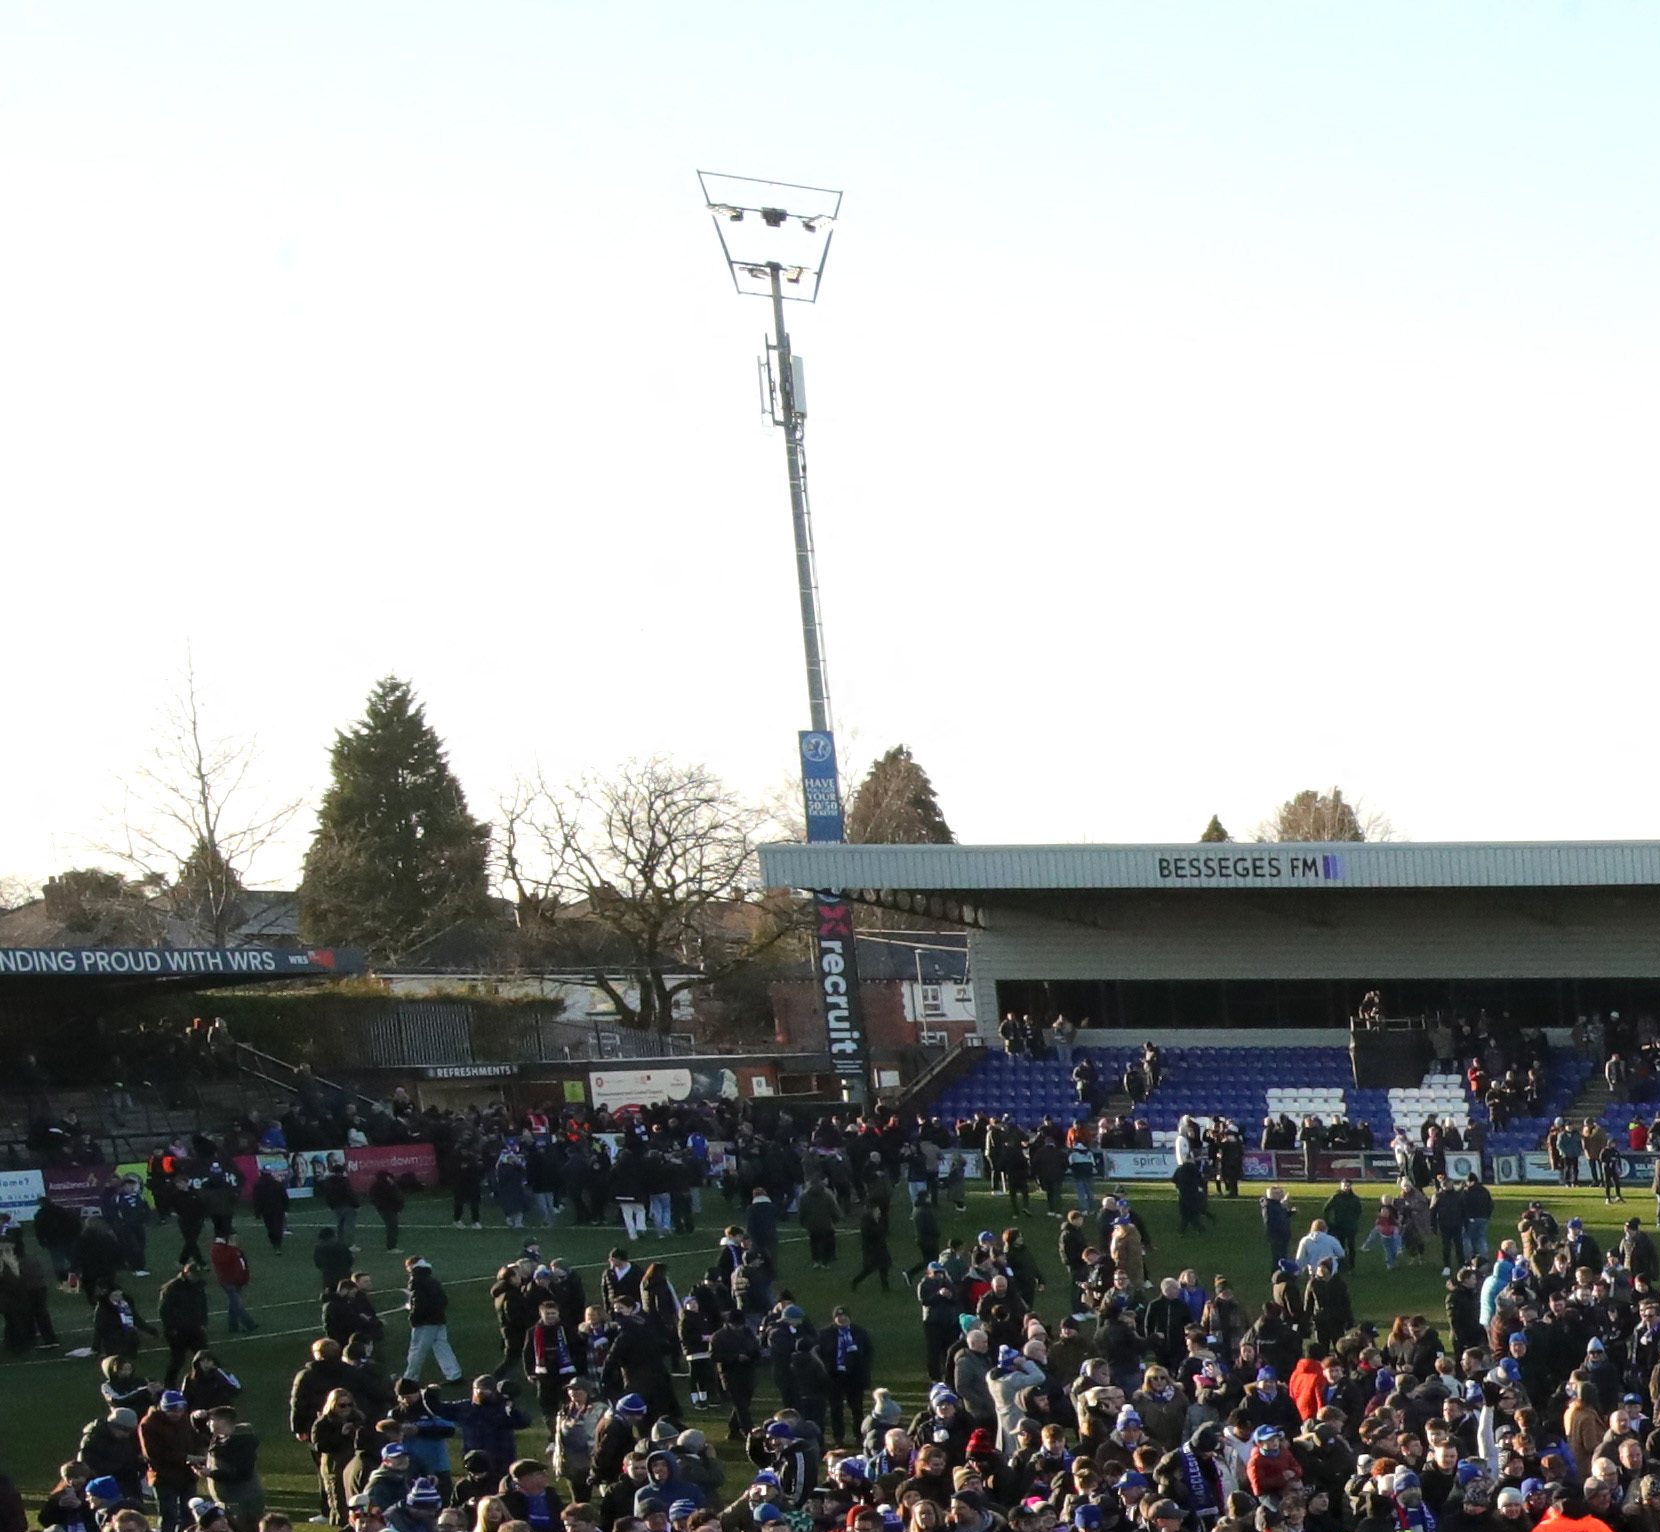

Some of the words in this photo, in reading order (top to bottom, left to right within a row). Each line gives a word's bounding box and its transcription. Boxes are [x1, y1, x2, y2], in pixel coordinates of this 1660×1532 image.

[805, 779, 835, 788] HAVE
[806, 792, 837, 801] YOUR
[807, 801, 838, 810] 50/50
[1158, 858, 1282, 878] BESSEGES
[1290, 857, 1319, 878] FM
[82, 951, 162, 972] PROUD
[164, 951, 223, 972] WITH
[225, 951, 276, 971] WRS
[820, 939, 861, 1054] recruit
[436, 1066, 511, 1078] REFRESHMENTS
